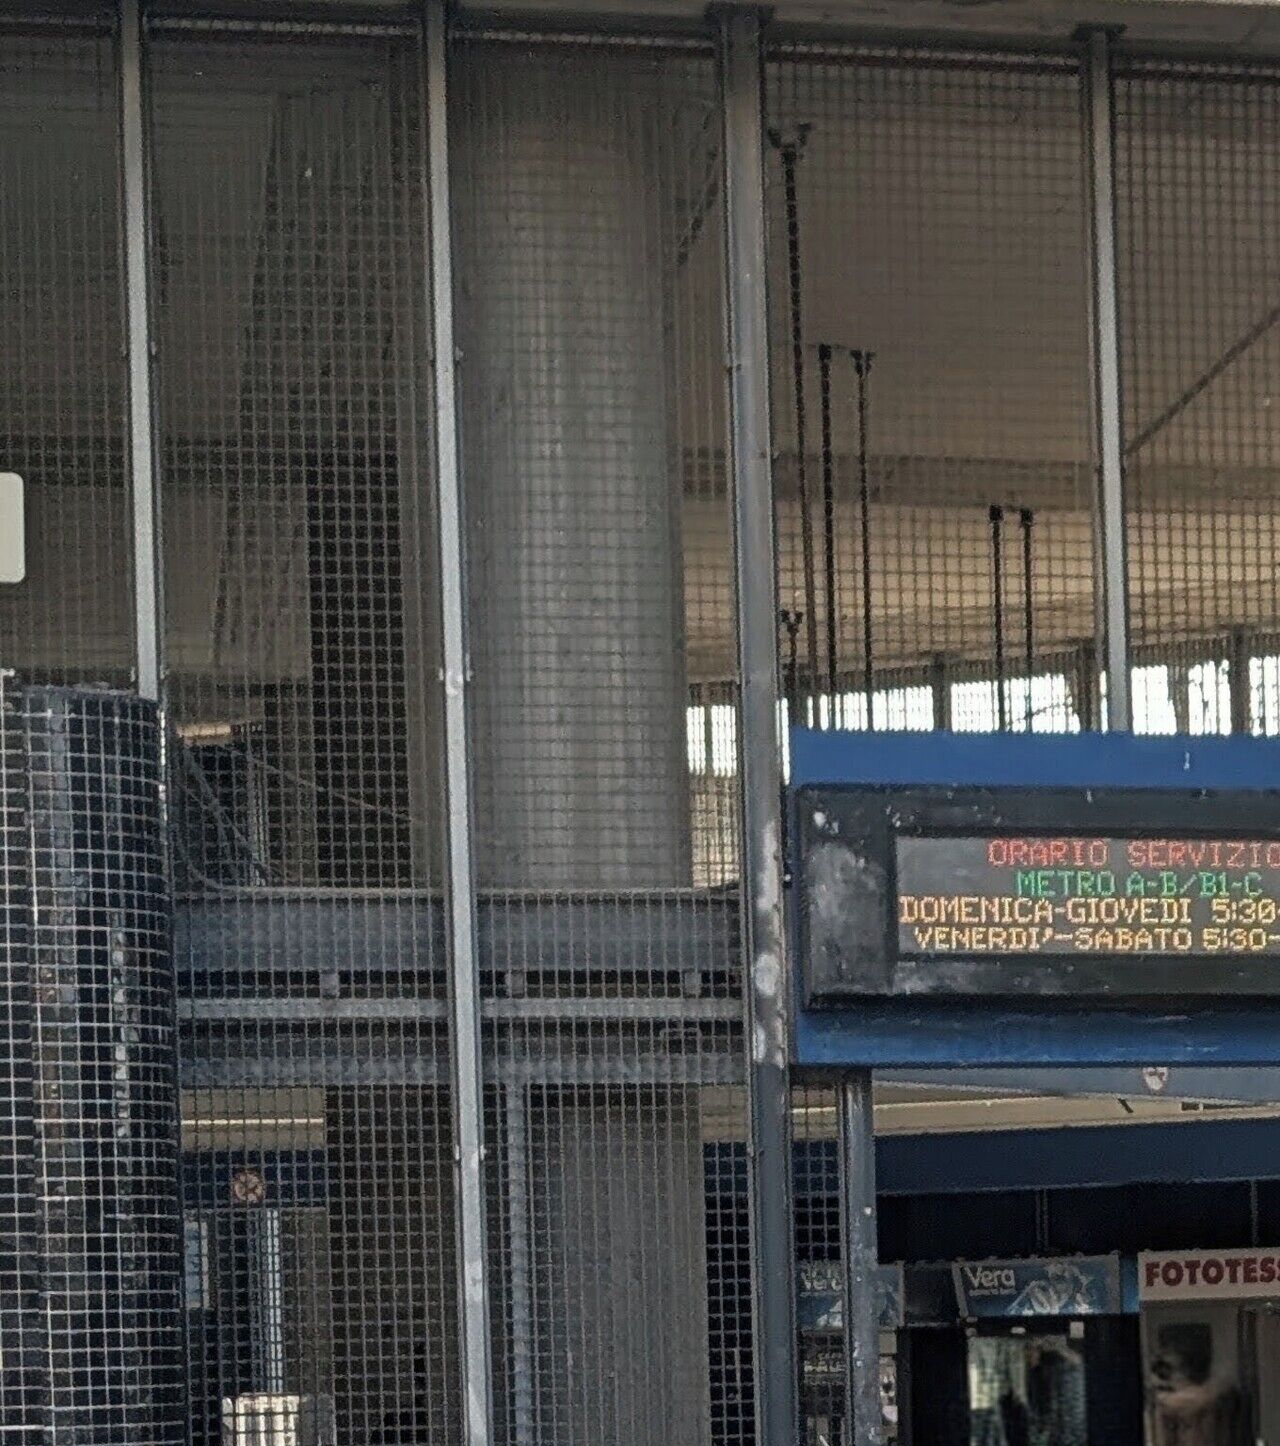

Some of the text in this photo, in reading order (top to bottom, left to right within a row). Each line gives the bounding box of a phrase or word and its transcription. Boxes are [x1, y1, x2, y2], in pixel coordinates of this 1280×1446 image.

[987, 840, 1108, 867] ORARIO
[1015, 871, 1264, 897] METRO A-B/B1-C
[899, 897, 1192, 925] DOMENICA-GIOVEDI
[964, 1266, 1016, 1288] Vera
